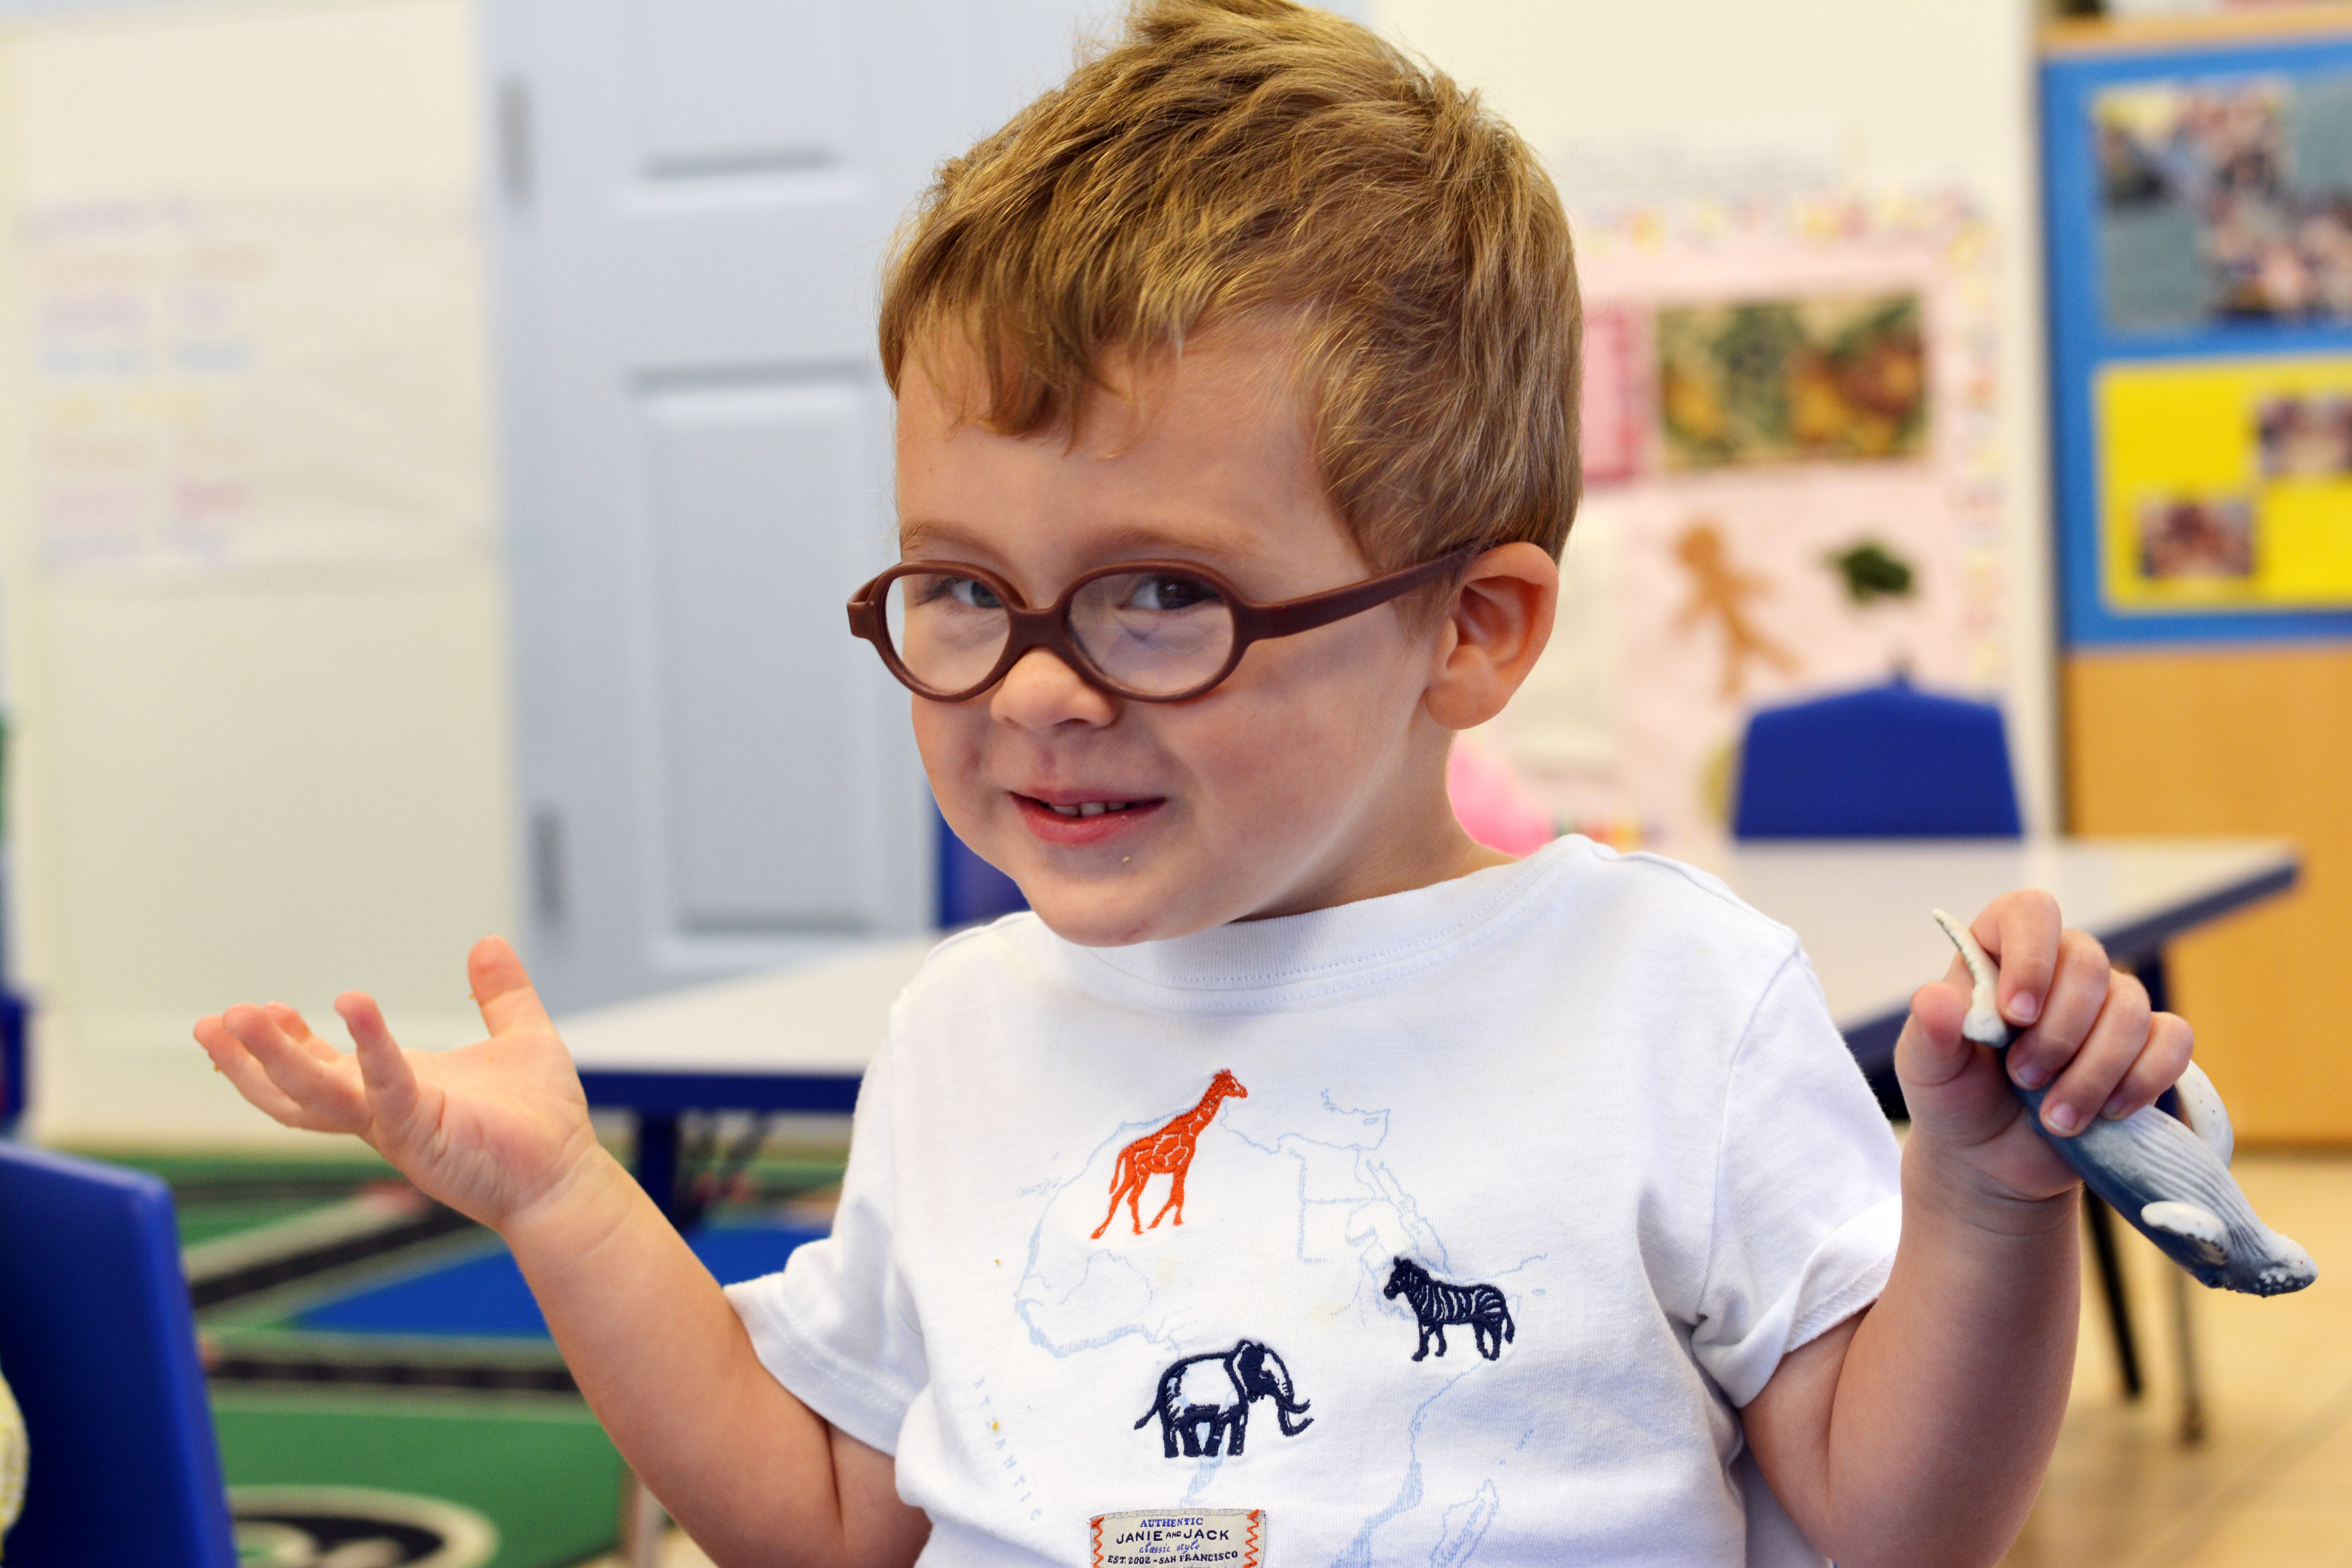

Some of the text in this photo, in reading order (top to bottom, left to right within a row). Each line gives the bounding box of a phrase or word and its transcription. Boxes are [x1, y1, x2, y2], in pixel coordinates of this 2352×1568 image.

[1140, 1517, 1203, 1527] AUTHENTIC
[1116, 1529, 1229, 1544] JANIE AND JACK
[1139, 1539, 1200, 1554] classic style
[1180, 1550, 1238, 1563] FRANCISCO
